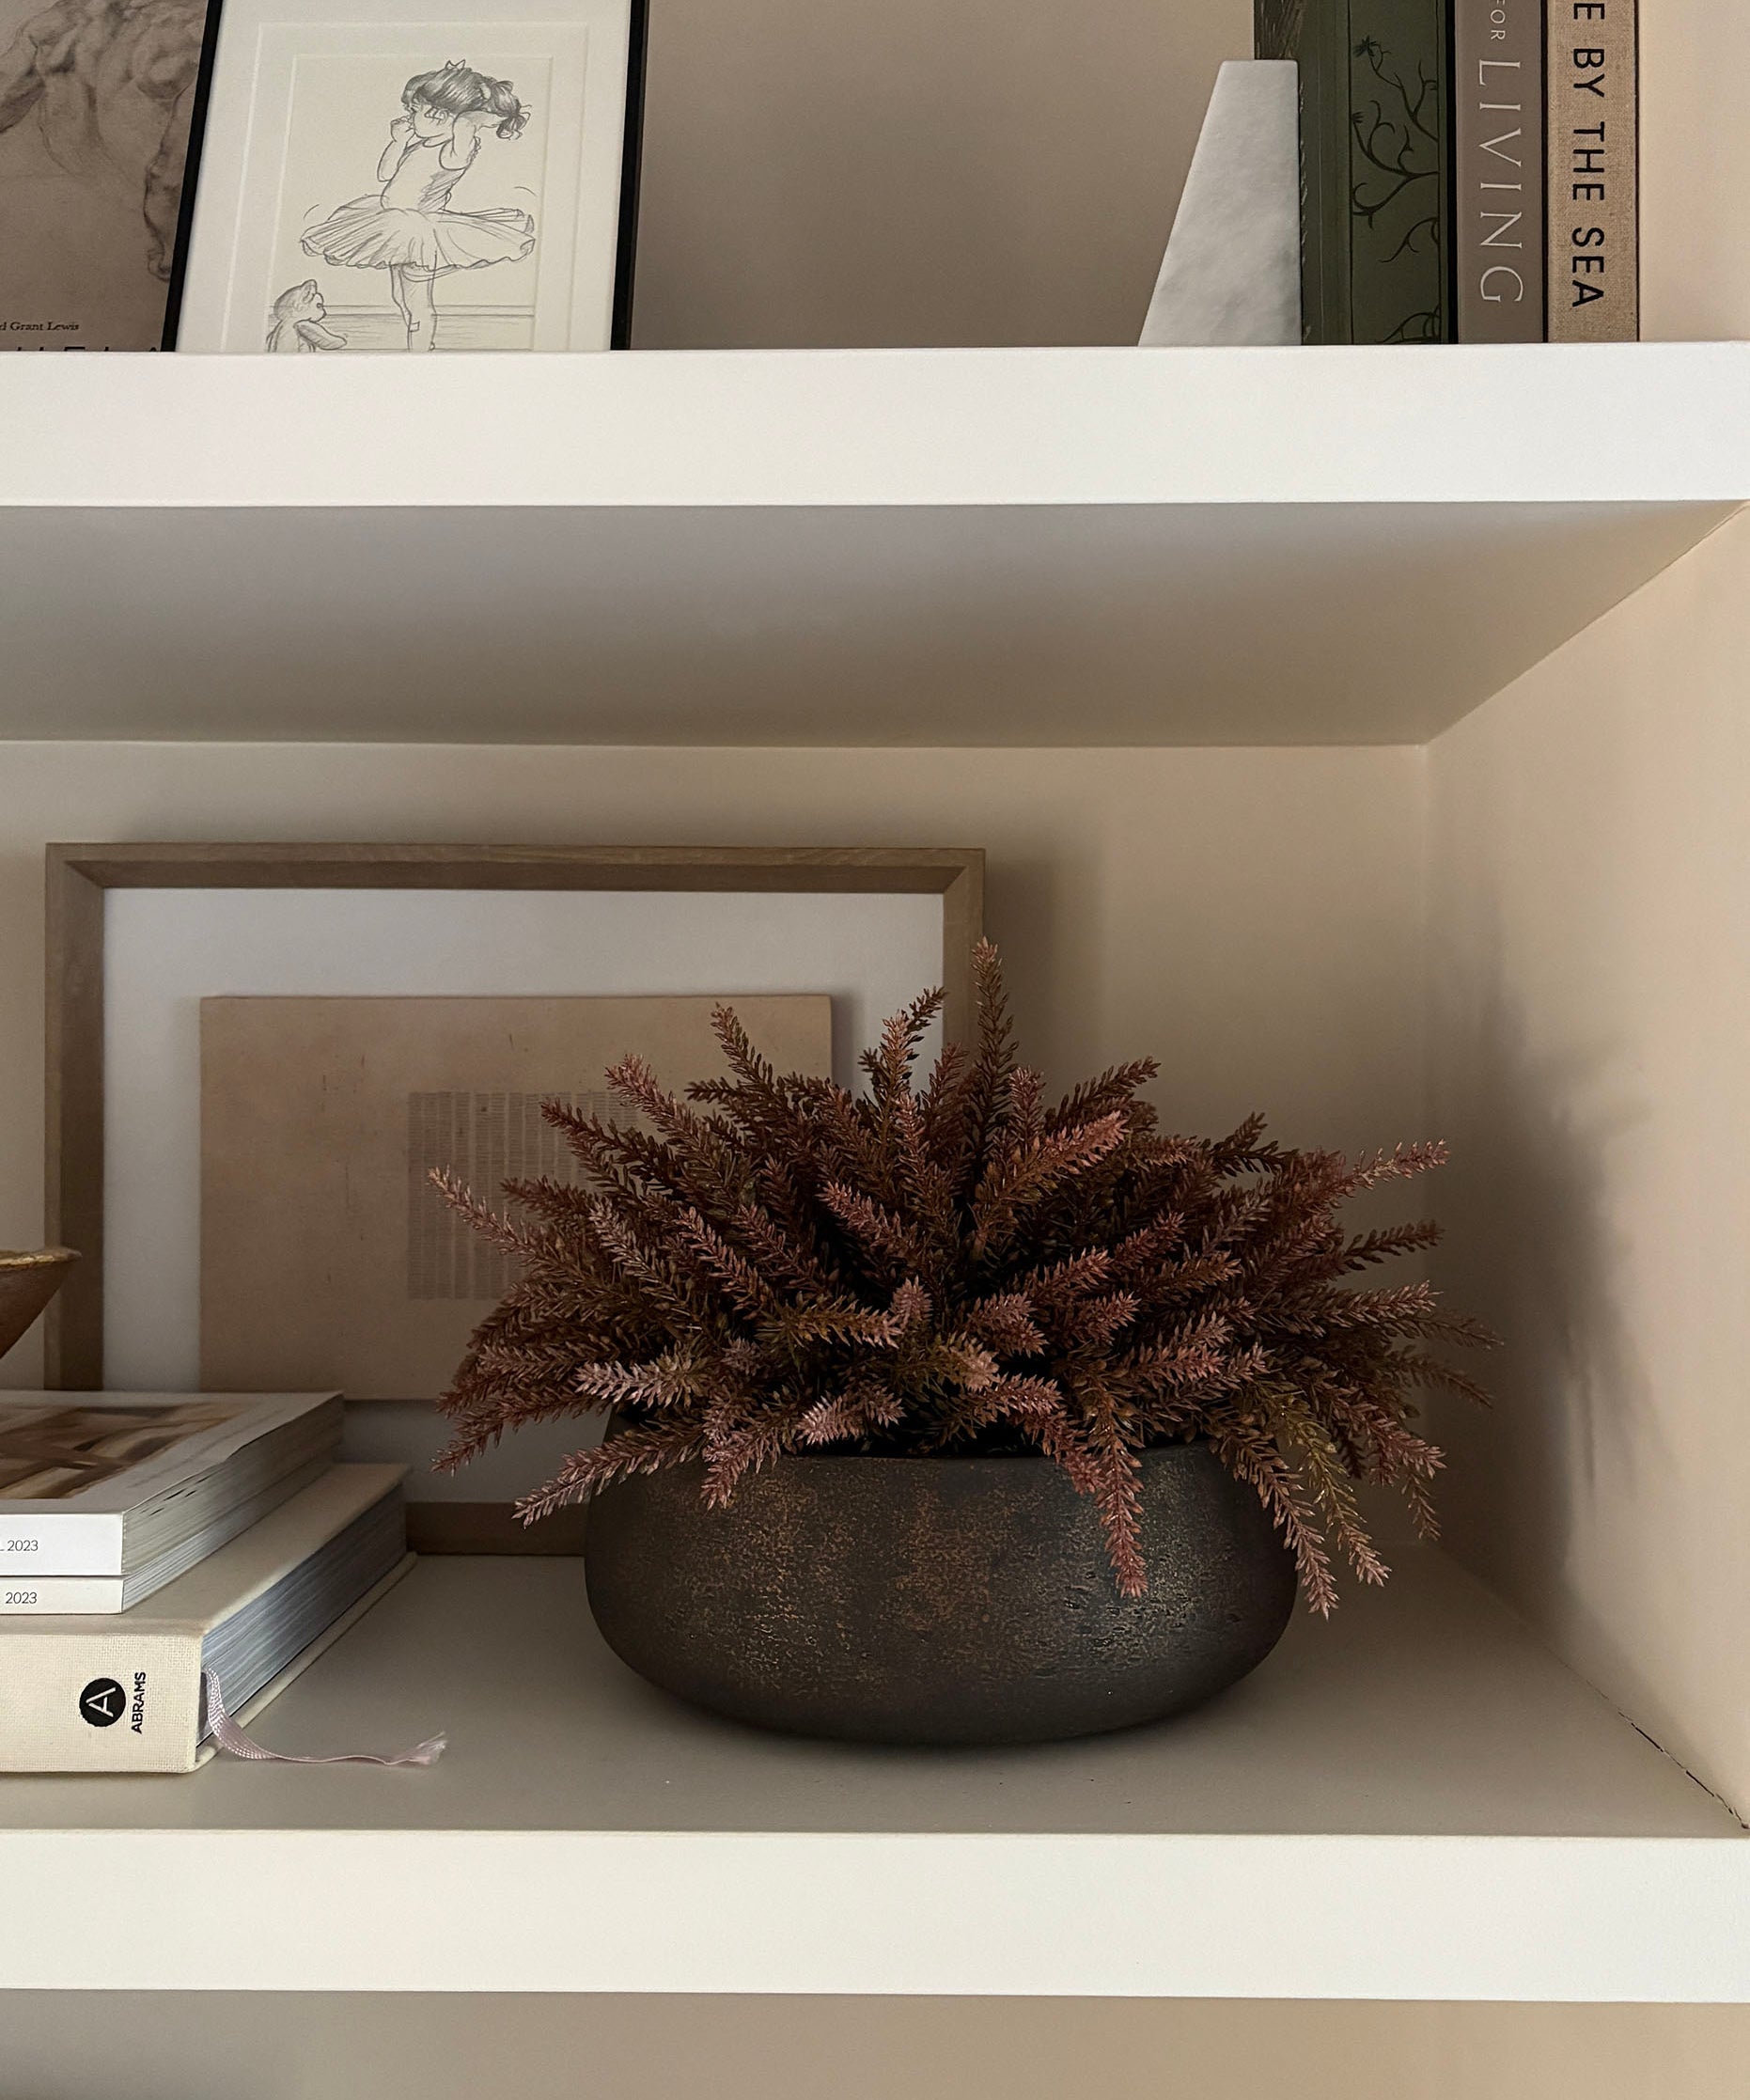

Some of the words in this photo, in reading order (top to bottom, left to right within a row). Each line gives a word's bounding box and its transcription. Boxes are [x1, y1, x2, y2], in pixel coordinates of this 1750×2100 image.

[1572, 48, 1604, 98] BY
[1478, 59, 1523, 302] LIVING
[1572, 121, 1604, 200] THE
[1571, 227, 1604, 306] SEA
[9, 321, 43, 331] Grant
[47, 321, 80, 331] Lewis
[7, 1540, 39, 1551] 2023
[5, 1591, 38, 1604] 2023
[86, 1687, 117, 1717] A
[131, 1671, 147, 1734] ABRAMS
